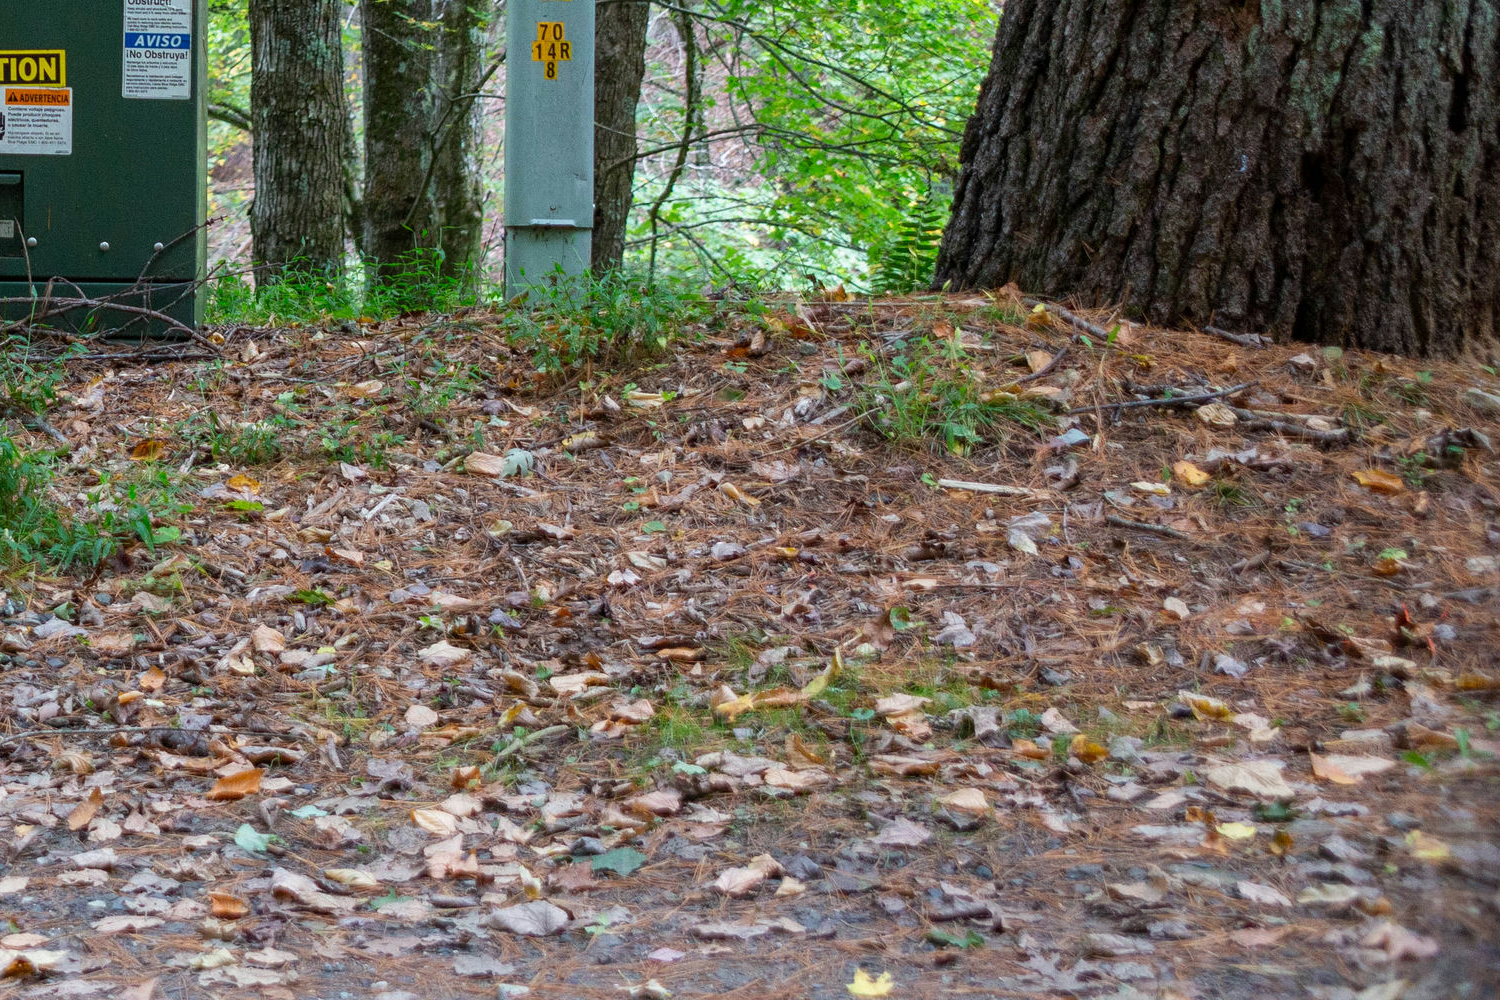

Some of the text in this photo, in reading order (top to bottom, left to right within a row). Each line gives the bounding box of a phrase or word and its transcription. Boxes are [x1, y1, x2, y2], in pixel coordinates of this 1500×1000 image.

[539, 23, 563, 40] 70
[134, 34, 182, 47] AVISO
[126, 50, 188, 61] ¡No Obstruya!
[535, 42, 570, 59] 14R
[546, 61, 555, 78] 8
[19, 93, 69, 103] ADVERTENCIA
